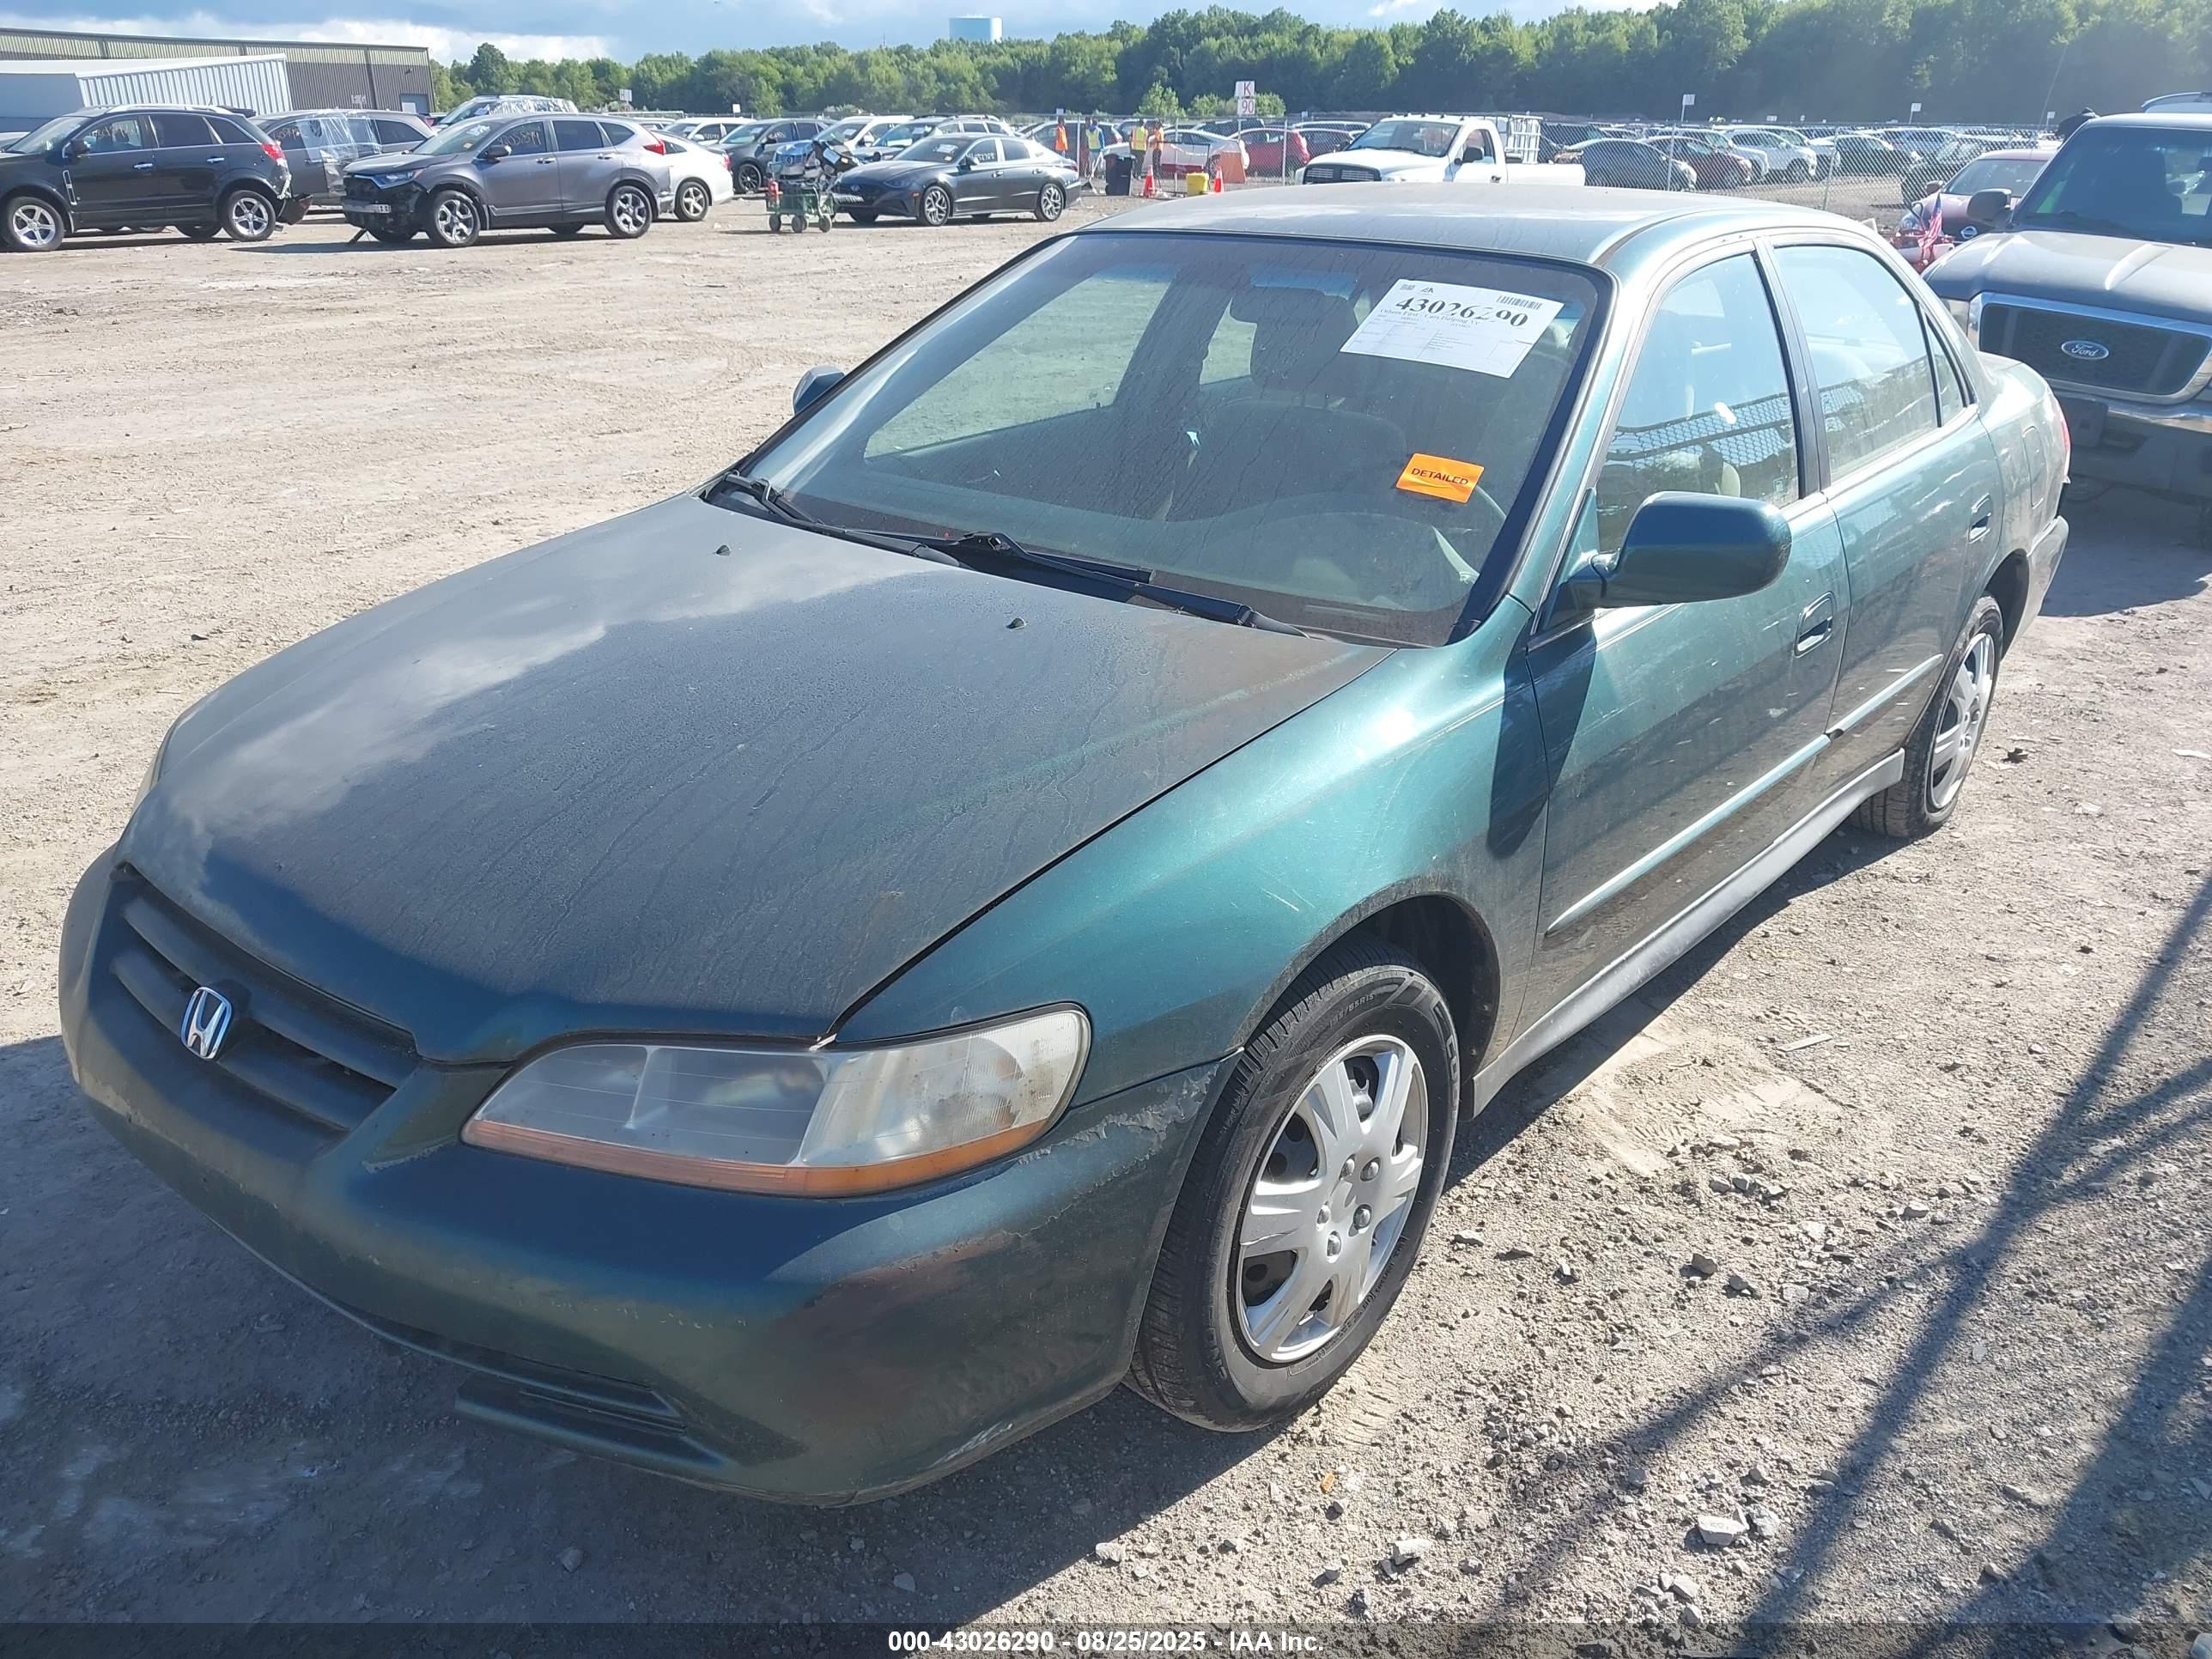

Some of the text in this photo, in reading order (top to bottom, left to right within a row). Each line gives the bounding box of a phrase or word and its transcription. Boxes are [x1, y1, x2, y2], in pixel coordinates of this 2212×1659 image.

[1243, 82, 1251, 95] K
[1242, 100, 1254, 113] 90
[1395, 297, 1528, 327] 43026290
[2070, 343, 2100, 357] Ford
[1411, 468, 1469, 485] DETAILED
